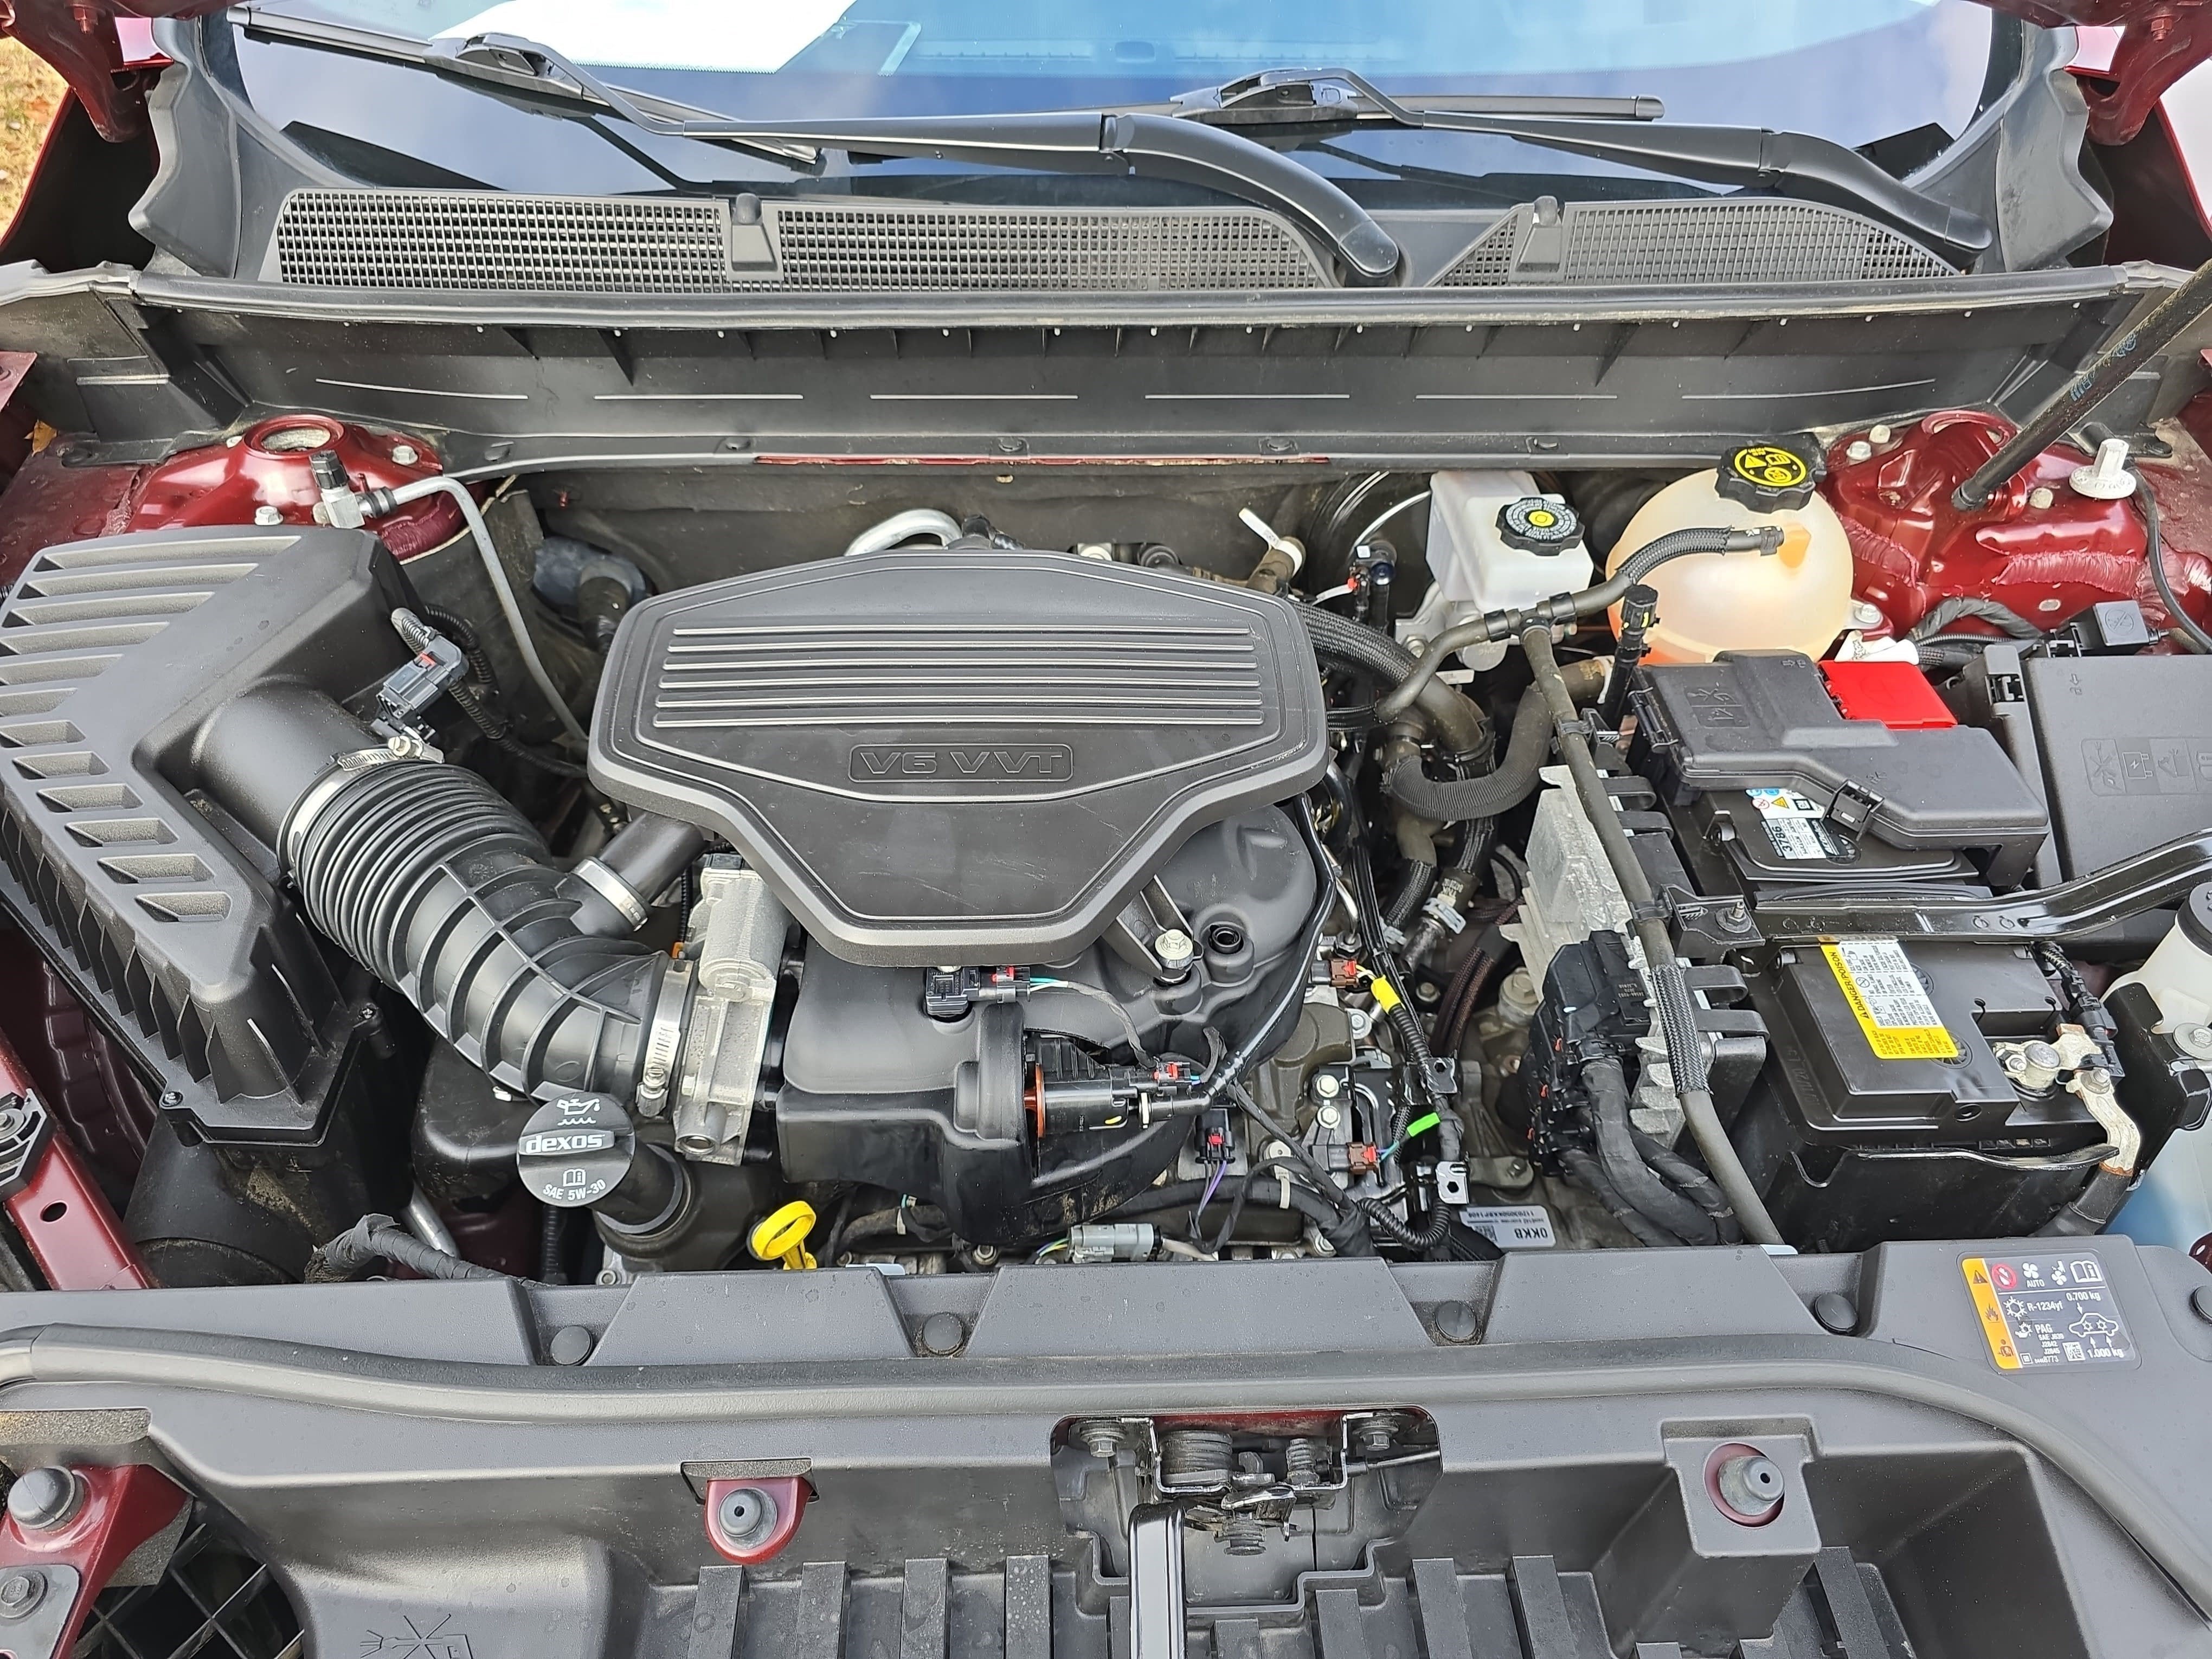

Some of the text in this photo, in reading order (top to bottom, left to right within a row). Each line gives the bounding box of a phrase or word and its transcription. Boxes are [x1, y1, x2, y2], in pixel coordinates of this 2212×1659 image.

[860, 751, 1063, 774] V6 VVT
[1771, 826, 1793, 852] 3786
[525, 1134, 603, 1154] dexos
[542, 1179, 607, 1201] SAE 5W-30
[2026, 1278, 2046, 1288] AUTO
[2066, 1291, 2101, 1302] 0.700 kg
[2027, 1301, 2065, 1312] R-1234yf
[2034, 1323, 2053, 1334] PAG
[2087, 1347, 2125, 1359] 1.000 kg
